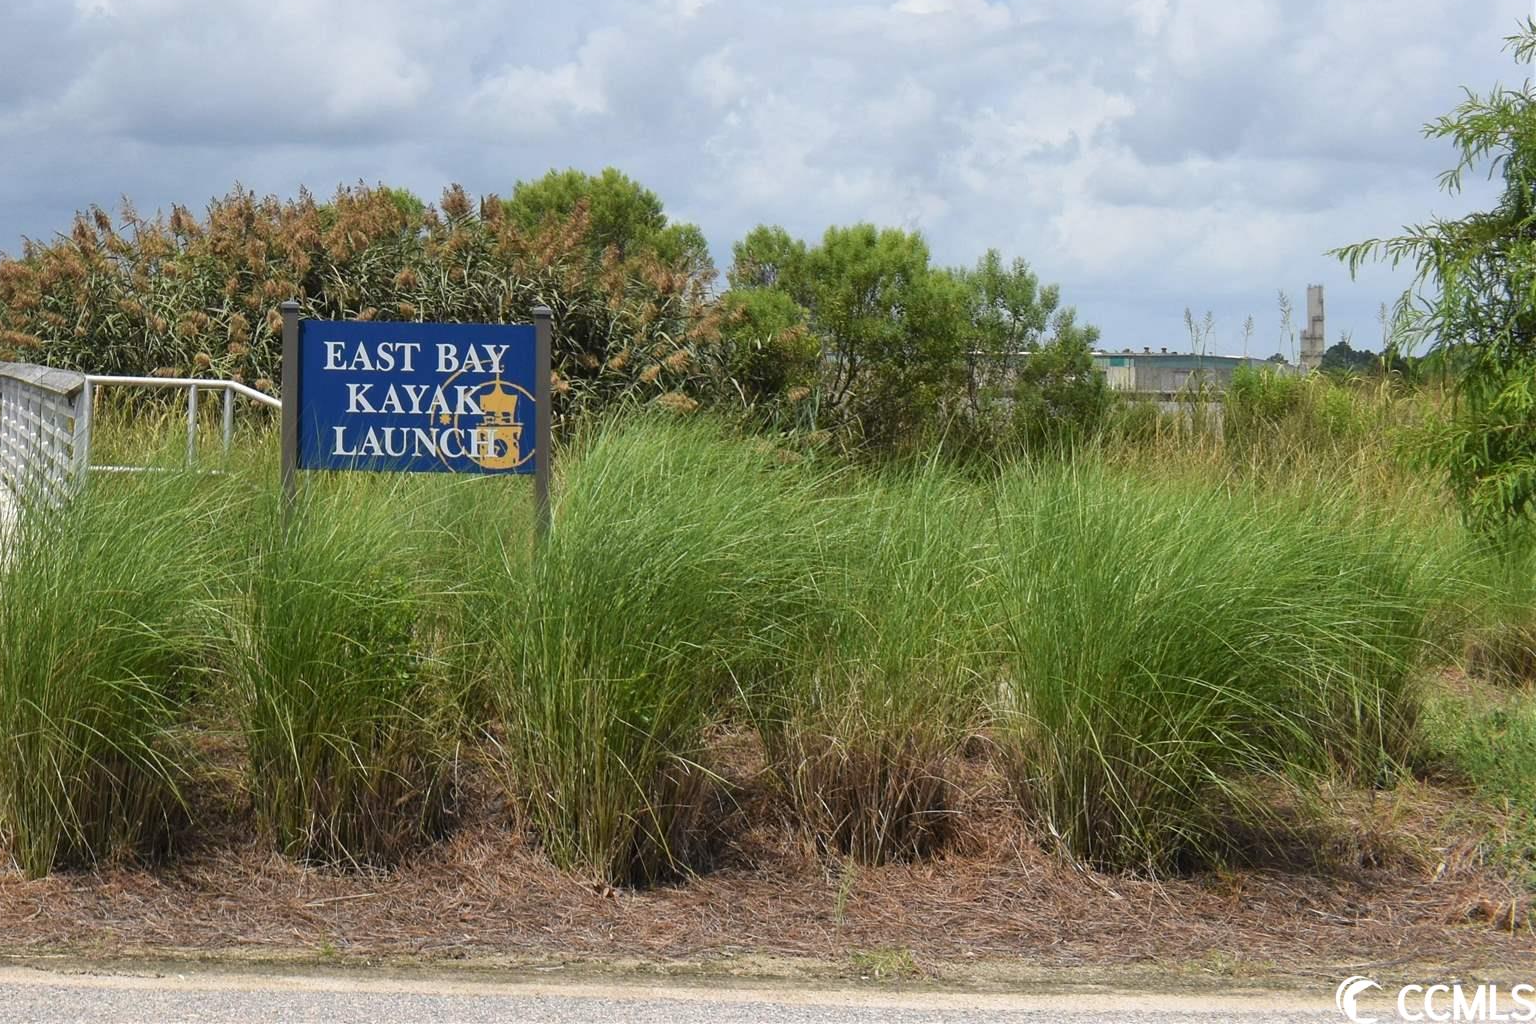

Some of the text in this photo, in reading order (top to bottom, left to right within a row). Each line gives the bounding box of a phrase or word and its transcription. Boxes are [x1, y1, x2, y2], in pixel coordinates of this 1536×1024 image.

[323, 341, 510, 373] EAST BAY
[346, 383, 486, 415] KAYAK
[332, 426, 498, 458] LAUNCH
